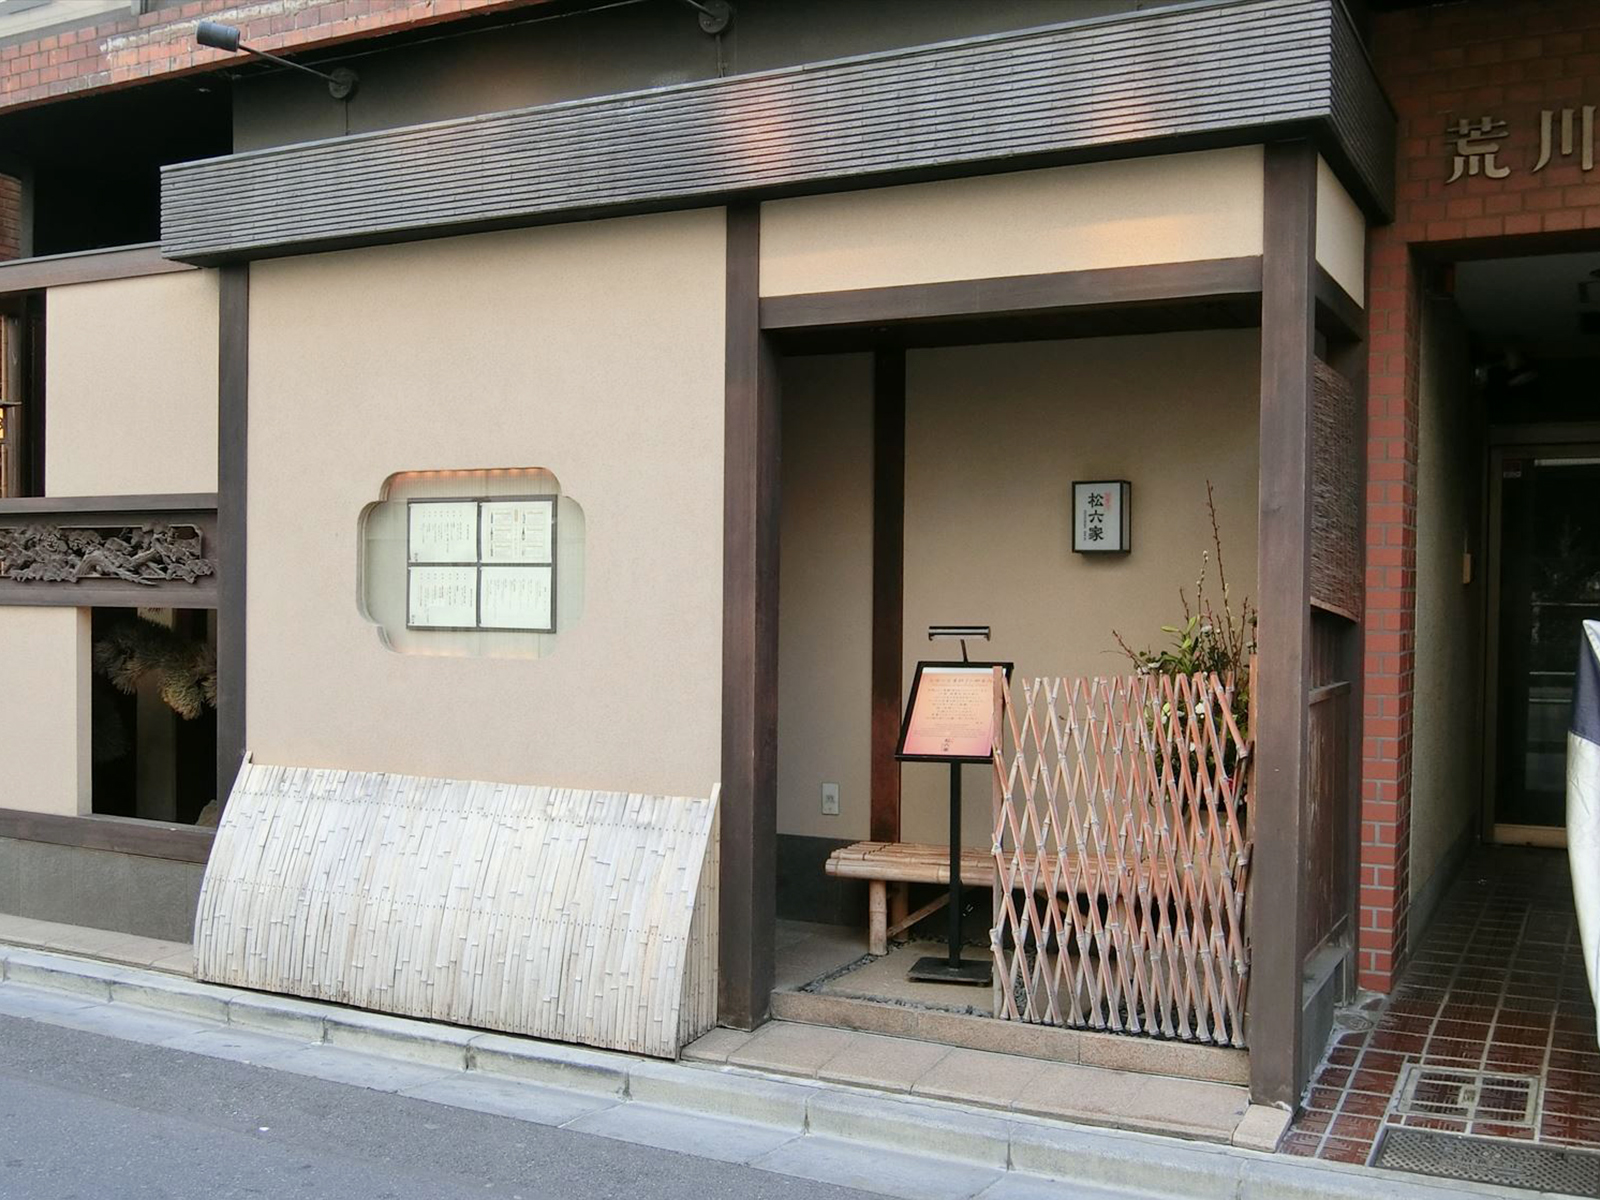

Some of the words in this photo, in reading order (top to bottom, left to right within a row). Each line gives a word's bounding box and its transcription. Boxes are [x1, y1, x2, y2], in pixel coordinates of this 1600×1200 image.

[1444, 105, 1597, 184] 荒川
[1087, 492, 1104, 542] 松六家
